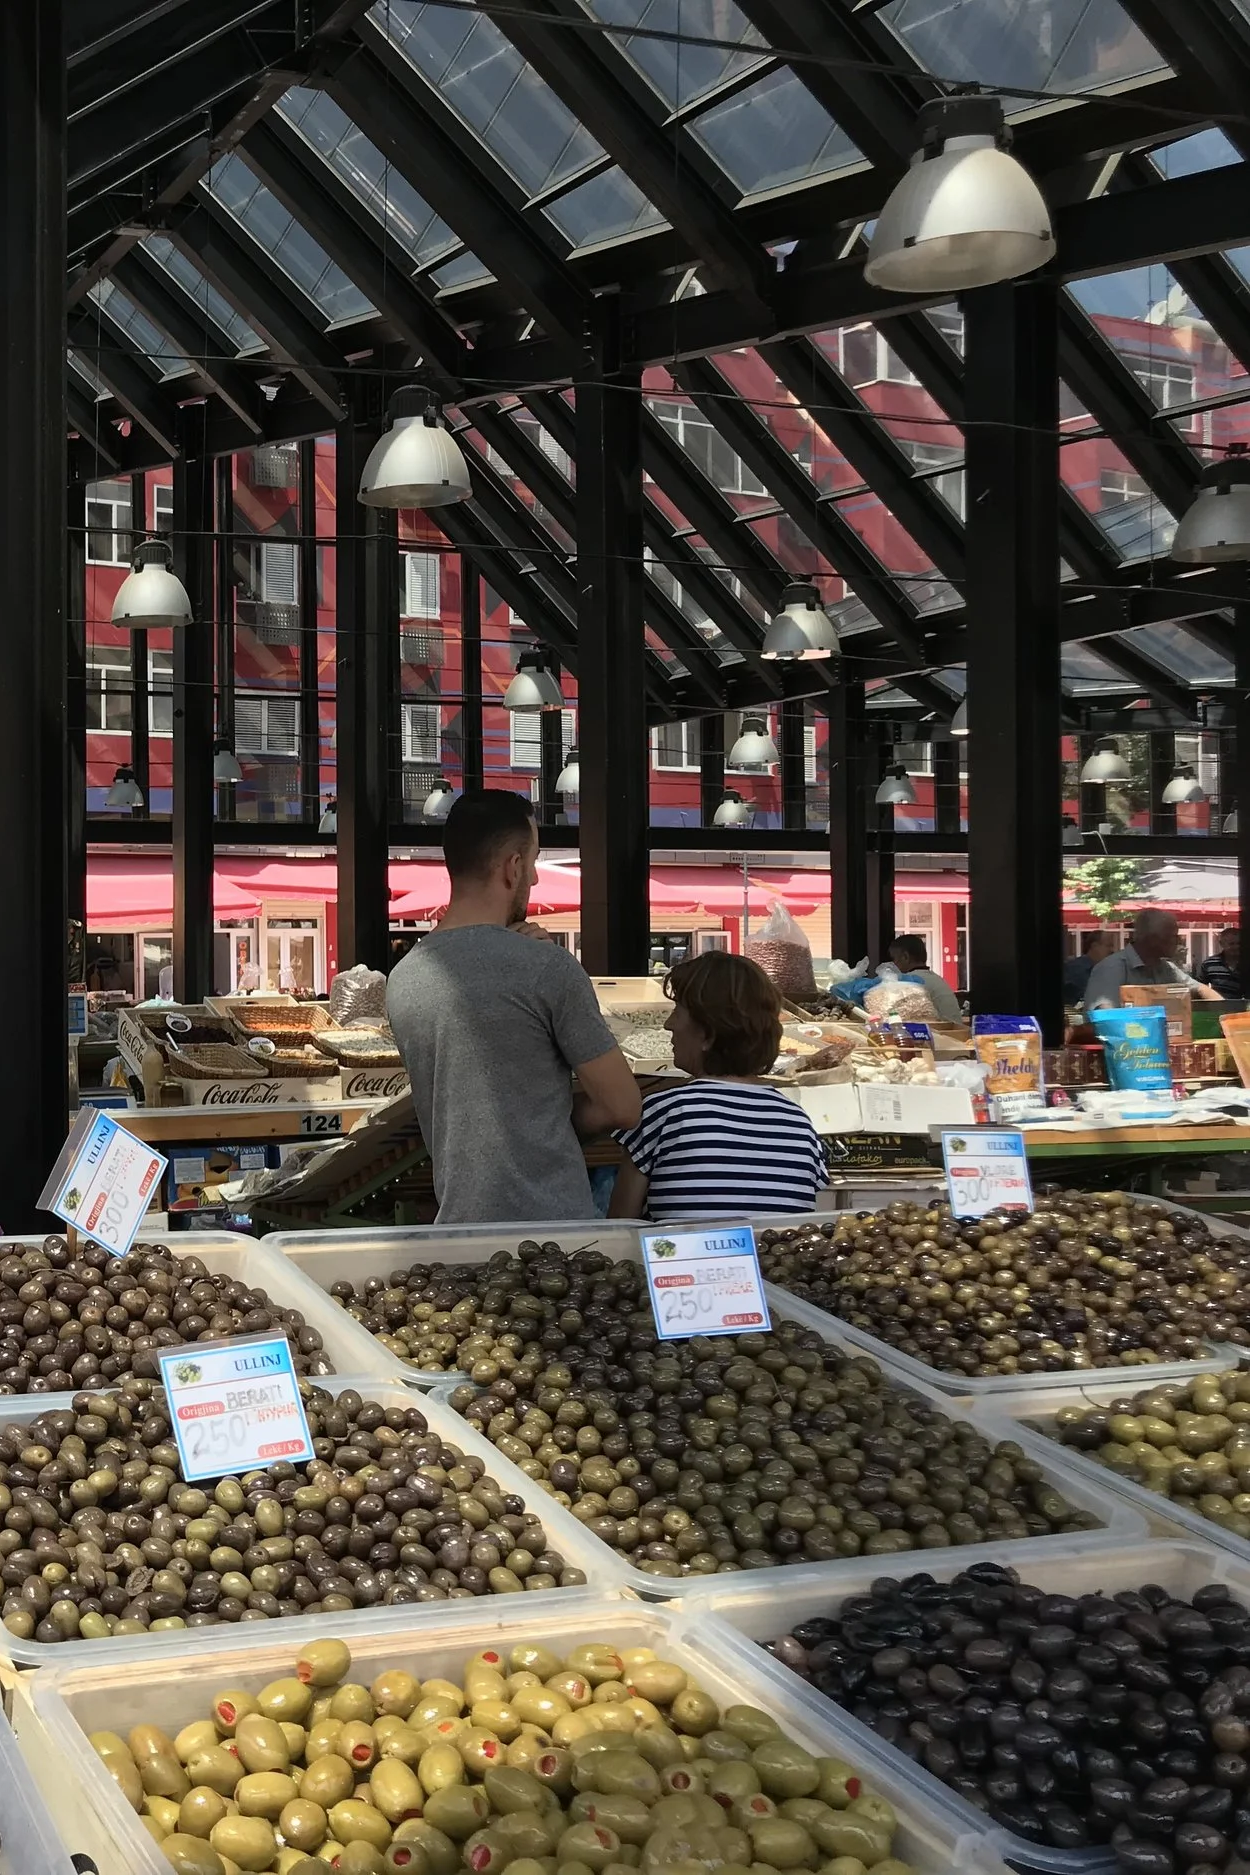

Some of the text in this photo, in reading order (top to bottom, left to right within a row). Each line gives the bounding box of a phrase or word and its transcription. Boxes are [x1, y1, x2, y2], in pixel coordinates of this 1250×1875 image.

[346, 1072, 411, 1099] Coca-Co
[302, 1115, 341, 1132] 124
[87, 1125, 111, 1165] ULLINJ
[705, 1238, 746, 1251] ULLINJ
[234, 1353, 282, 1372] ULLINJ
[182, 1403, 220, 1416] Origjina
